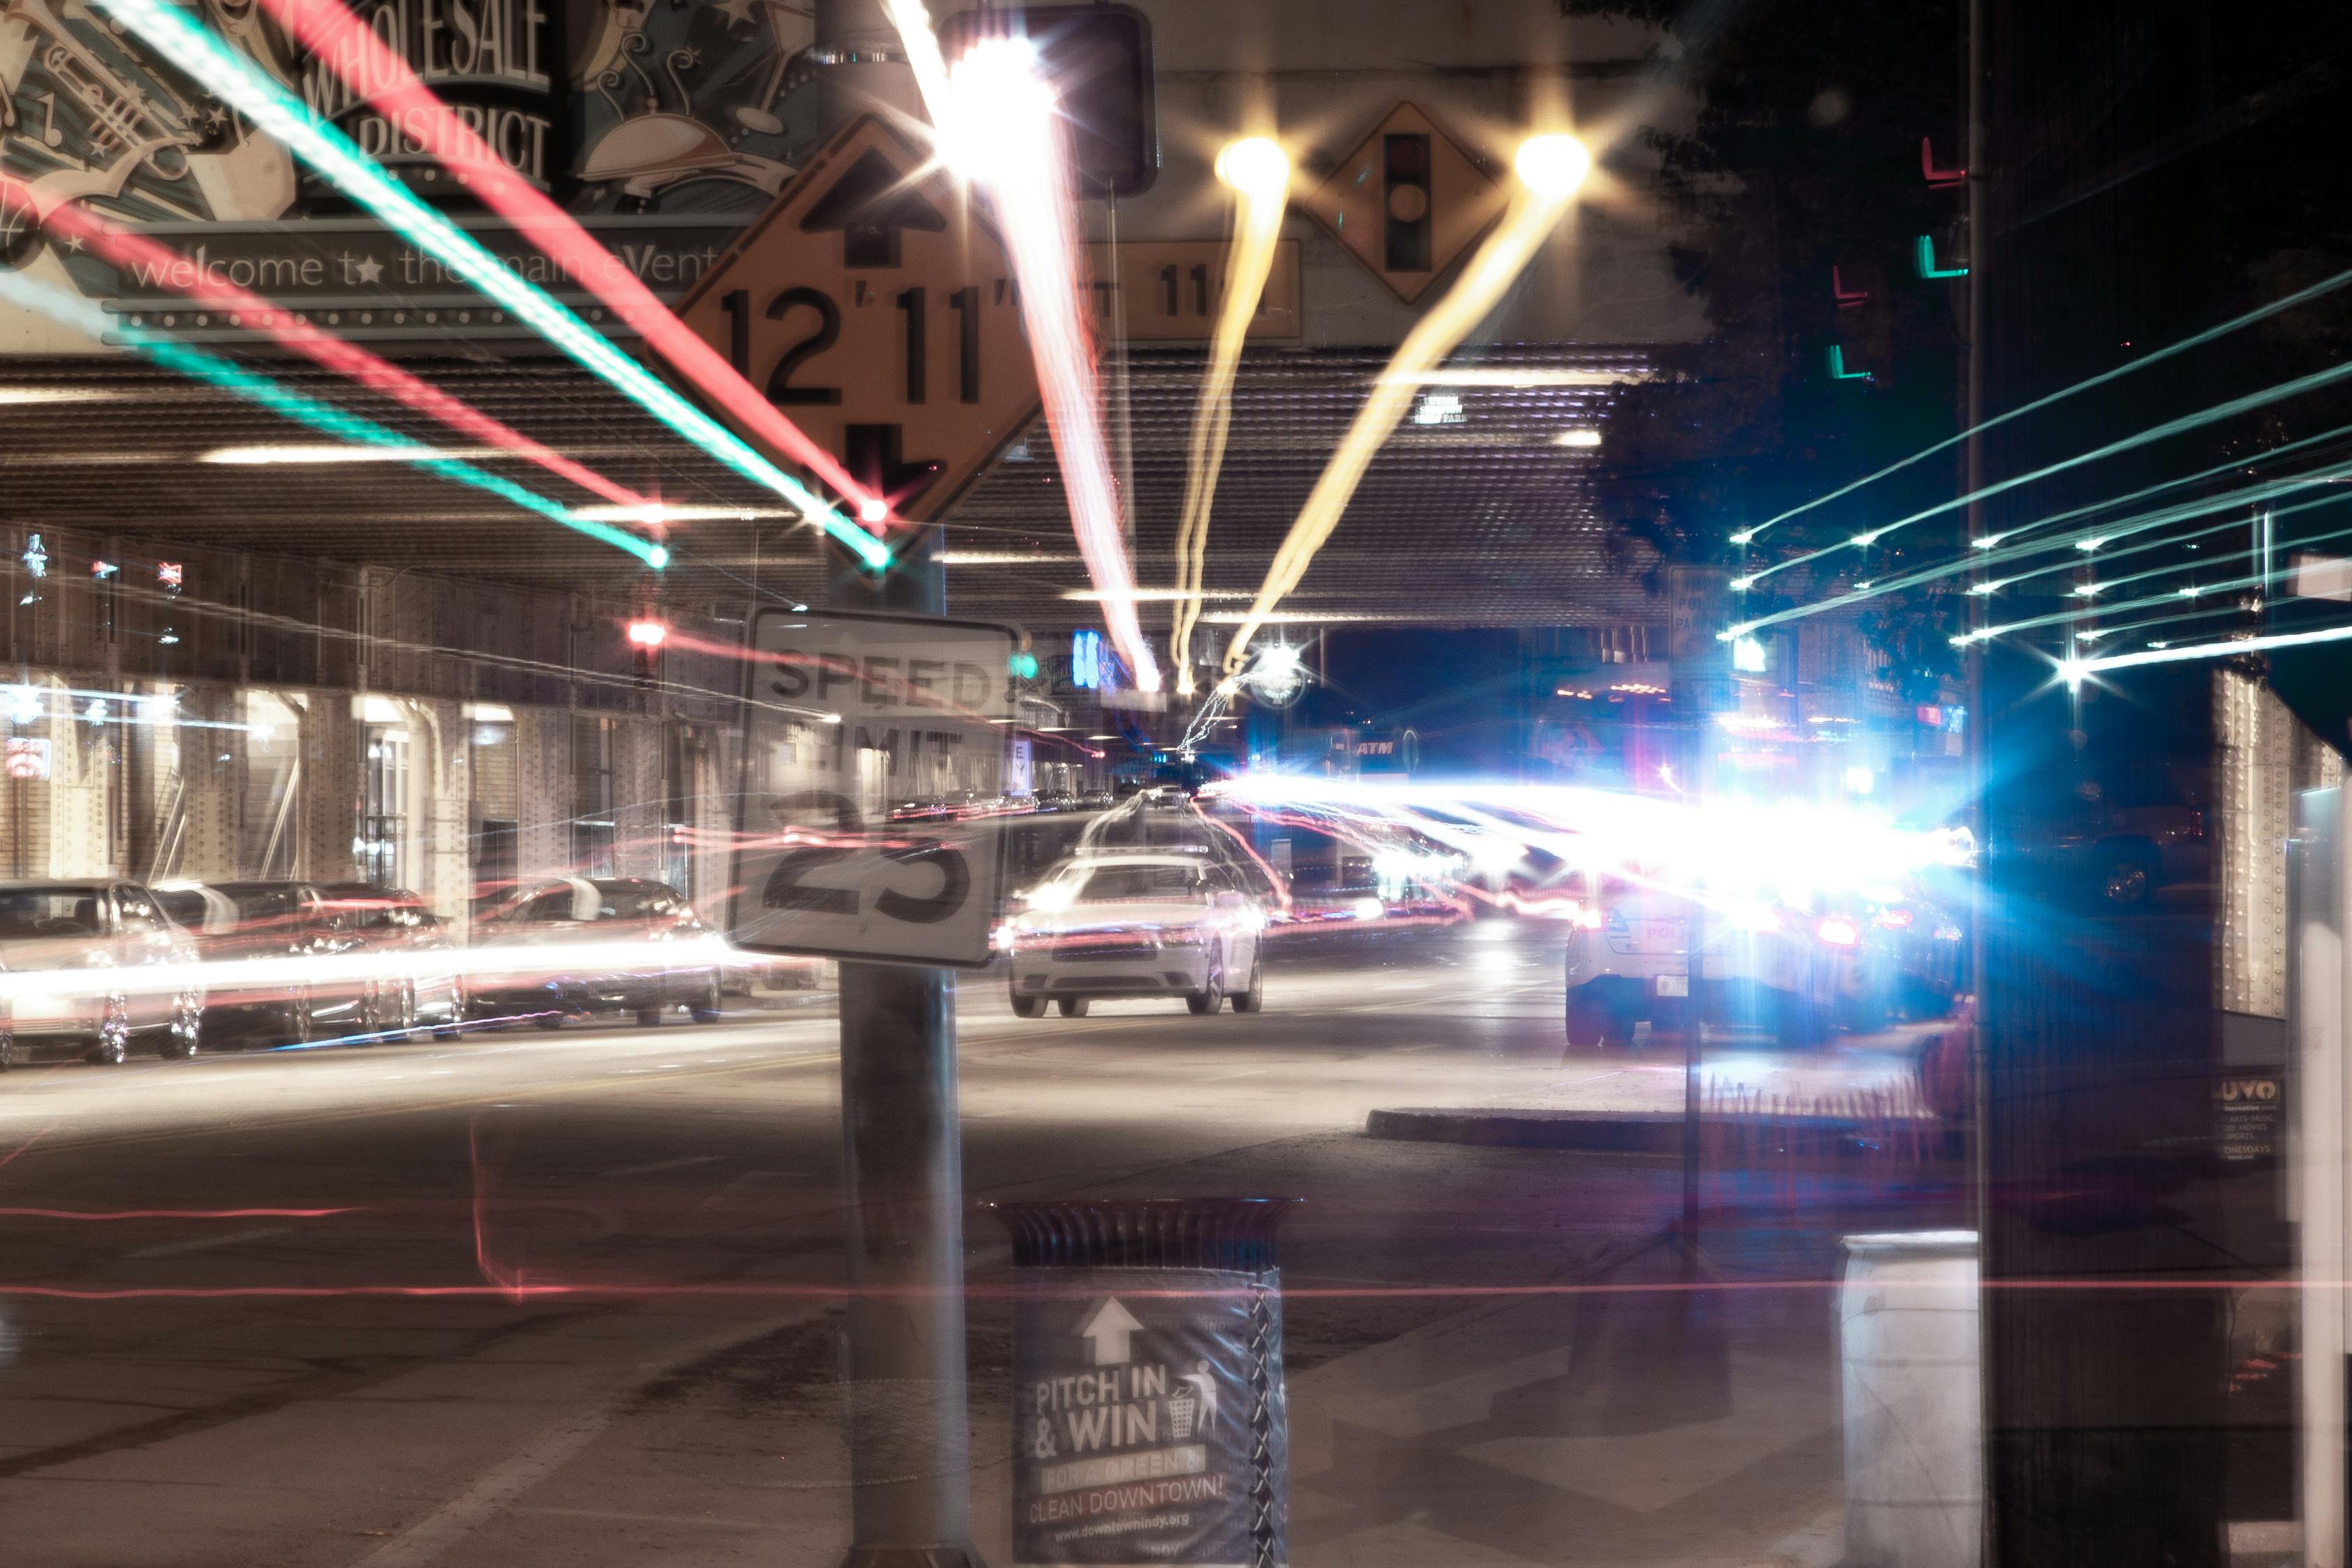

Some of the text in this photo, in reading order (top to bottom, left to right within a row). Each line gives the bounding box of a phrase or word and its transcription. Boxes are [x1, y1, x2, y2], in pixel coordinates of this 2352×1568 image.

[302, 0, 551, 125] WHOLESALE
[358, 105, 551, 180] DISTRICT
[131, 245, 324, 288] welcome
[399, 243, 468, 284] the
[1161, 263, 1207, 317] 11
[769, 648, 992, 712] SPEED
[796, 723, 964, 778] IMIT
[1355, 741, 1394, 755] ATM
[1036, 1364, 1166, 1415] PITCH IN
[1035, 1399, 1157, 1459] & WIN
[1029, 1475, 1224, 1524] CLEAN DOWNTOWN!
[1054, 1512, 1190, 1542] www.downtownindy.org
